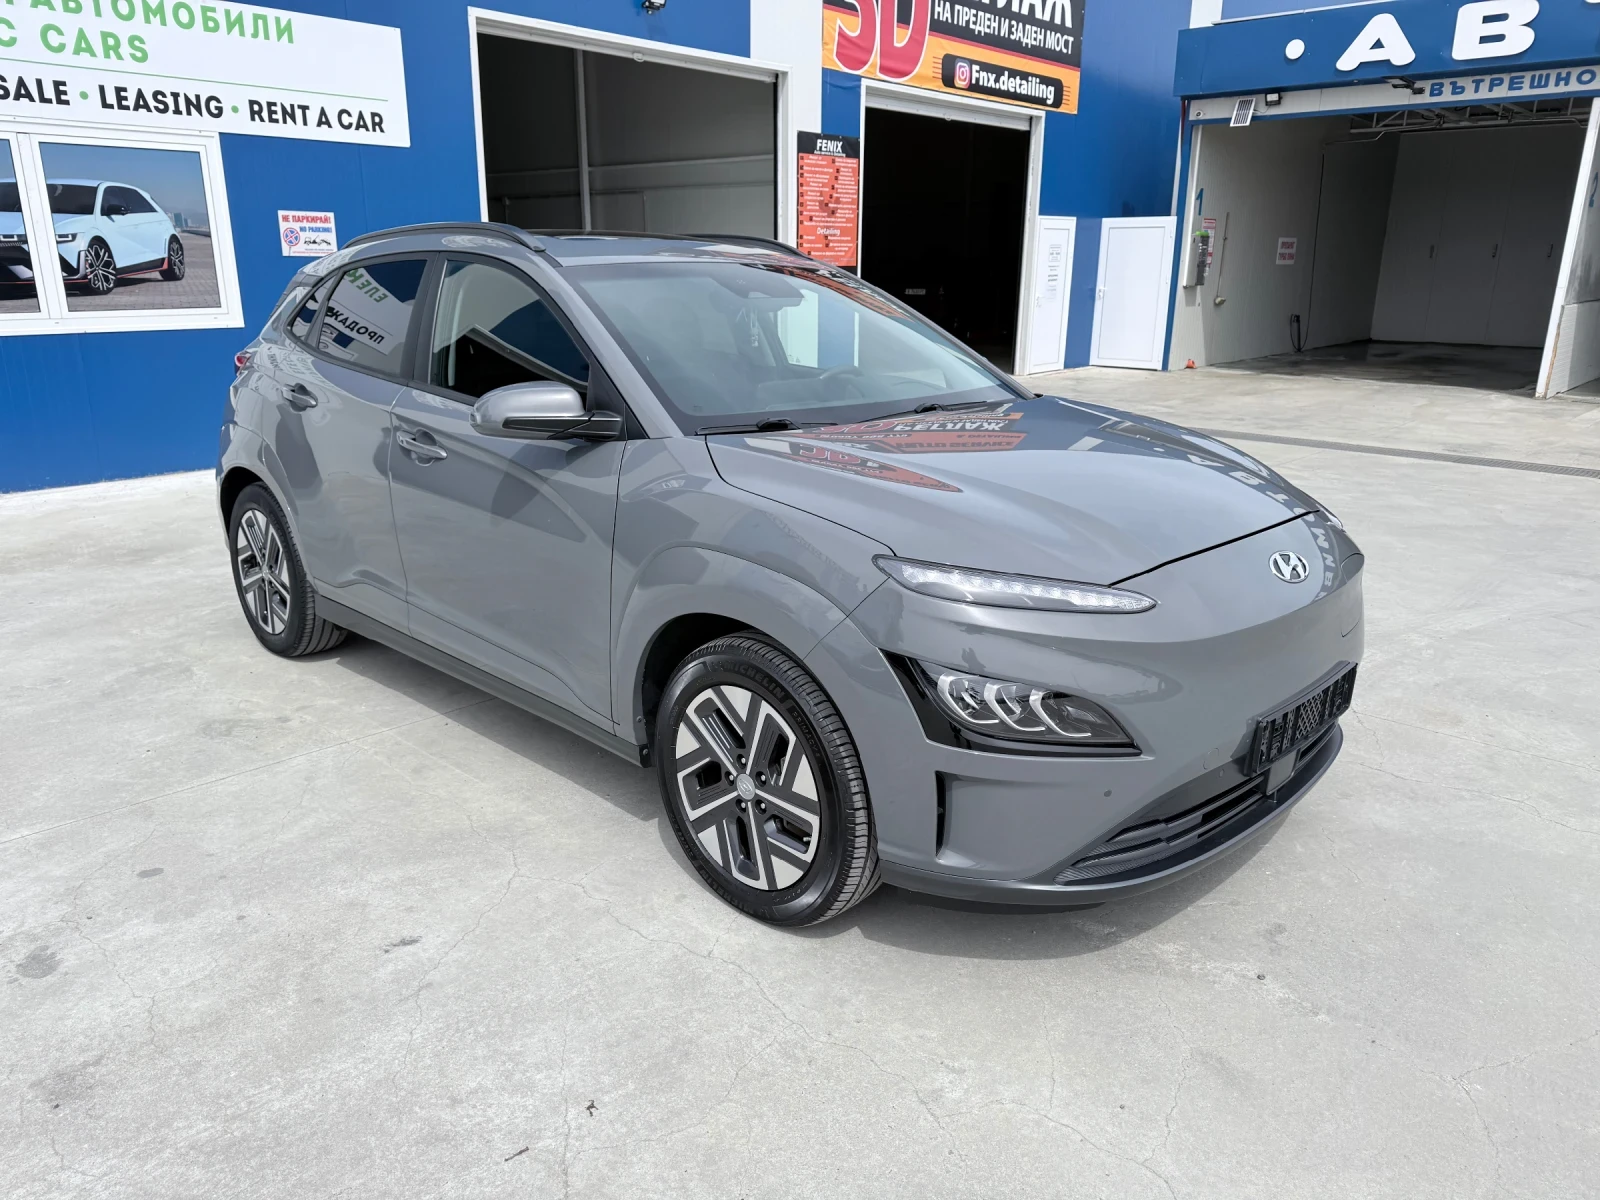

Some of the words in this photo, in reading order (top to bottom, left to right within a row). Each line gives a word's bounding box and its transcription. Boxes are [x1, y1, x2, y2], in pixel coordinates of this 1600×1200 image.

[40, 23, 149, 63] CARS
[934, 0, 951, 23] НА
[953, 4, 999, 36] ПРЕДЕН
[1000, 17, 1009, 38] И
[1010, 20, 1044, 48] ЗАДЕН
[1045, 29, 1074, 54] МОСТ
[1336, 0, 1600, 71] АВ
[0, 74, 71, 106] SALE
[98, 84, 224, 119] LEASING
[248, 99, 310, 126] RENT
[316, 106, 333, 129] A
[337, 108, 386, 133] CAR
[971, 64, 1055, 105] Fnx.detailing
[1429, 69, 1597, 98] ВЪТРЕШНО
[816, 138, 843, 153] FENIX
[281, 214, 291, 222] НЕ
[1196, 188, 1204, 216] 1
[817, 227, 840, 236] Detailing
[722, 660, 786, 701] MICHELIN
